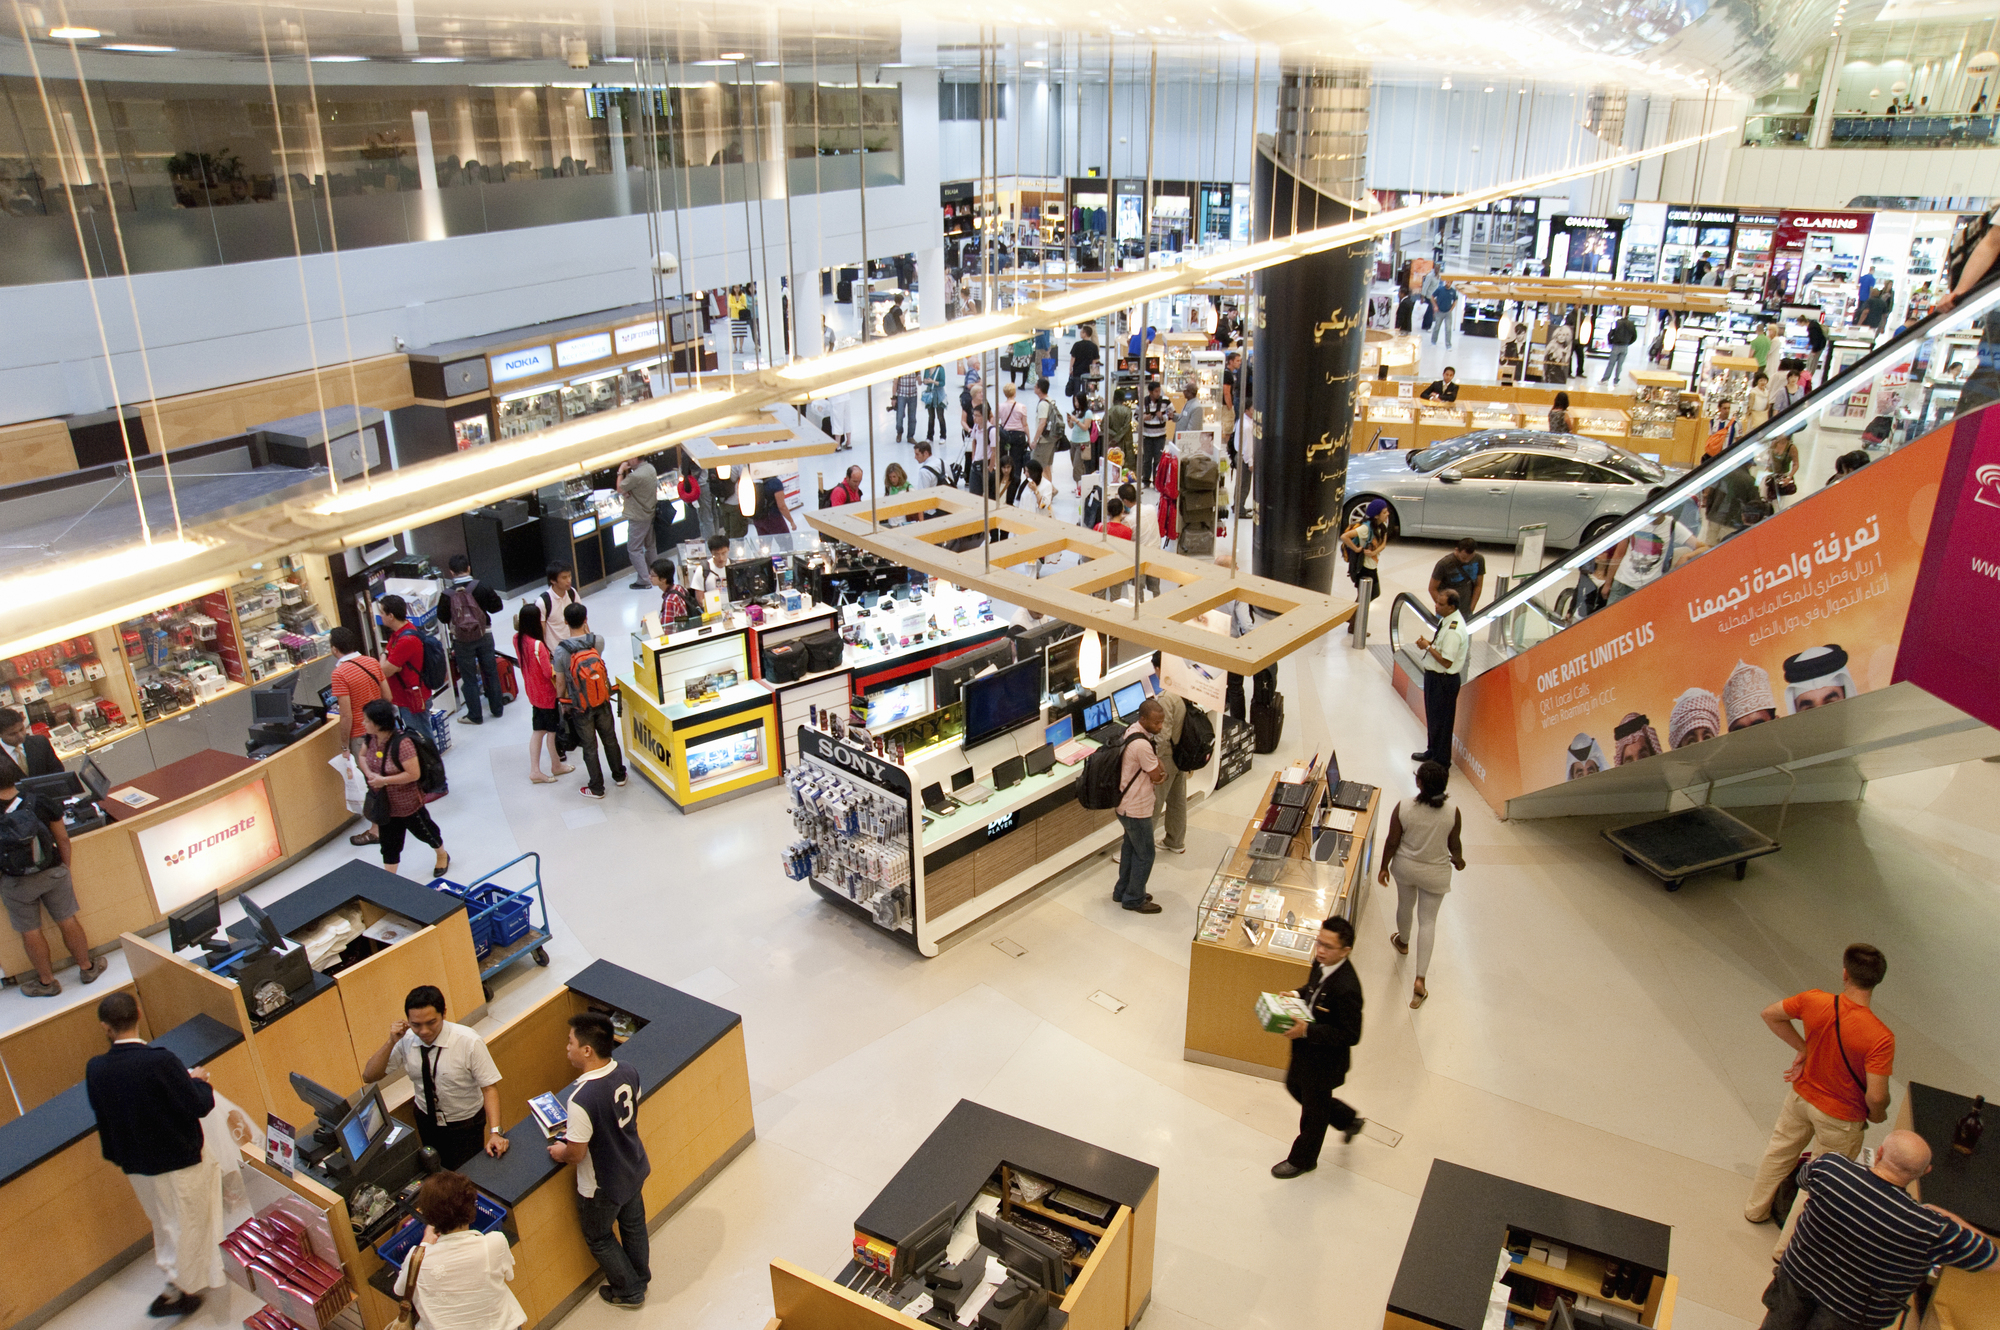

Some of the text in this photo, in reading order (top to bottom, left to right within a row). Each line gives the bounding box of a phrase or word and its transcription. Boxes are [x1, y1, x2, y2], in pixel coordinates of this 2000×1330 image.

[1793, 217, 1858, 230] CLARINS
[505, 356, 540, 371] NOKIA
[1688, 514, 1880, 623] تعرفة واحدة تجمعنا
[1814, 566, 1849, 596] قطري
[1850, 558, 1874, 581] ريال
[1748, 572, 1890, 647] أثناء التجوال في دول الخليج
[1754, 581, 1813, 618] للمكالمات
[1718, 605, 1755, 635] المحلية
[1537, 621, 1655, 693] ONE RATE UNITES US
[1540, 682, 1590, 716] QR1 Local Calls
[1541, 687, 1617, 729] when Roaming in GCC
[818, 738, 886, 781] SONY
[187, 815, 256, 859] promate
[987, 819, 1013, 837] PLAYER
